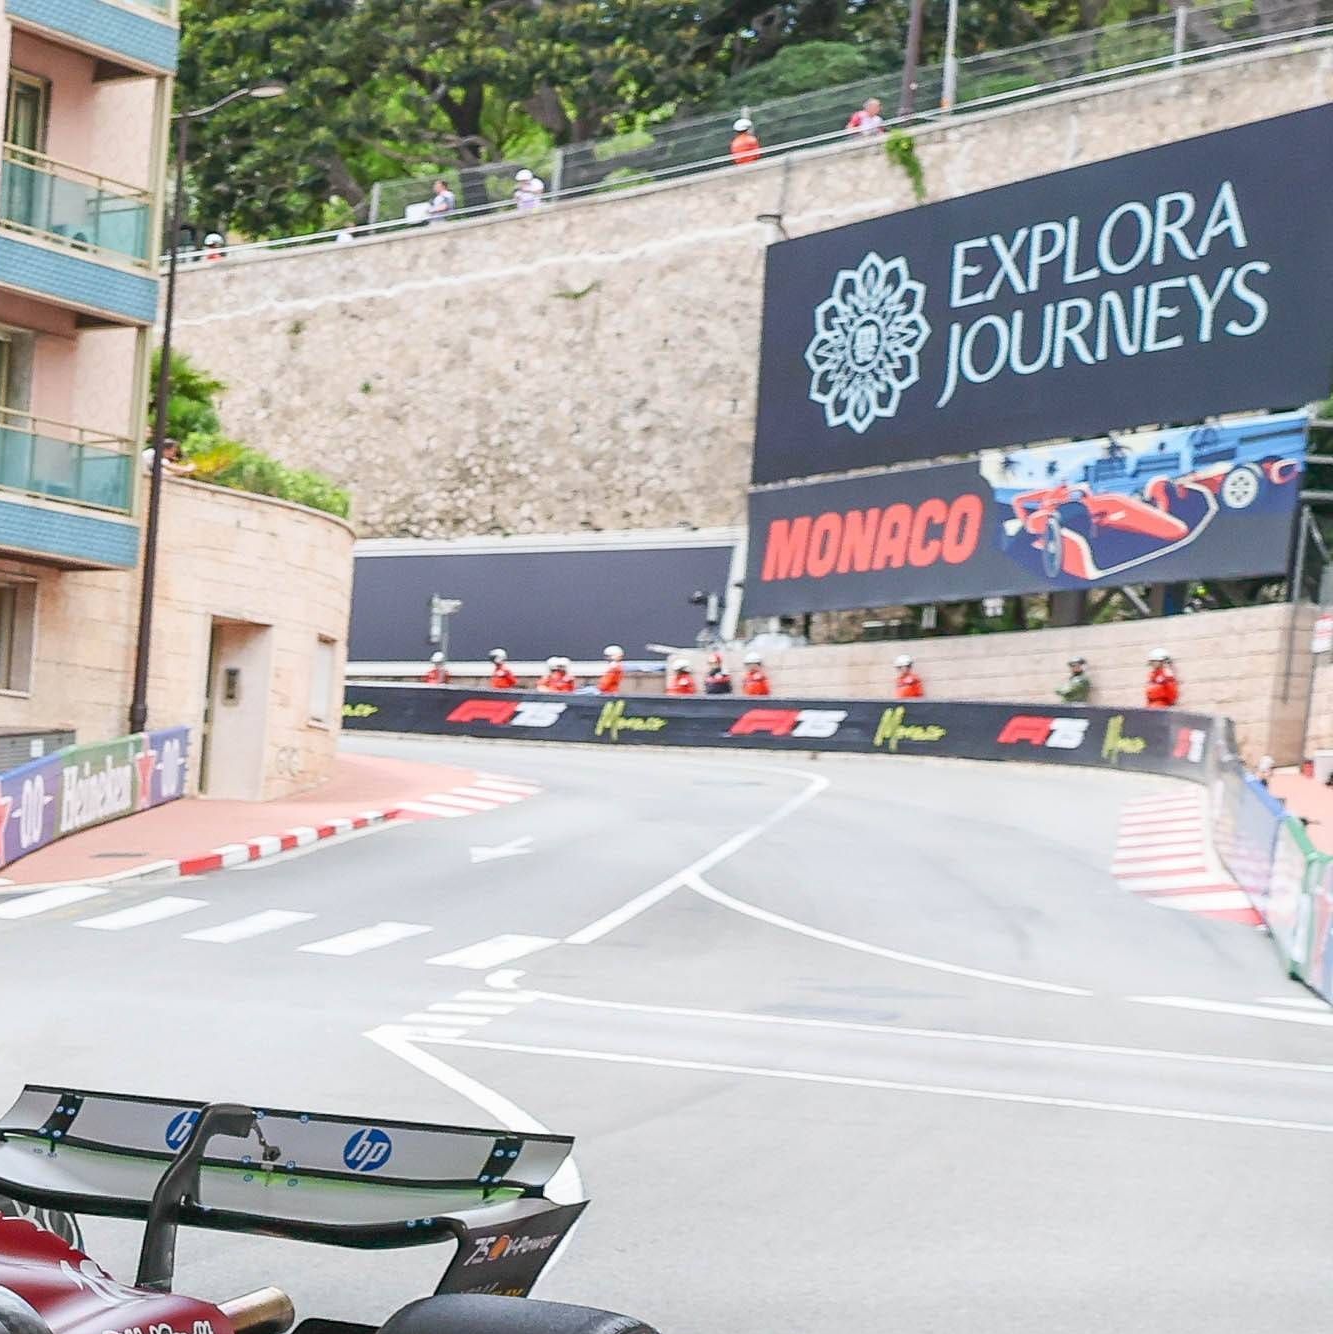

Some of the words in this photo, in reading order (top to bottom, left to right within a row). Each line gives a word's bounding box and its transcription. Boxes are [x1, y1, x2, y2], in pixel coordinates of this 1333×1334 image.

[950, 180, 1248, 308] EXPLORA
[935, 261, 1271, 409] JOURNEYS
[761, 493, 984, 582] MONACO
[61, 755, 132, 833] Heineken
[350, 1127, 390, 1172] hp
